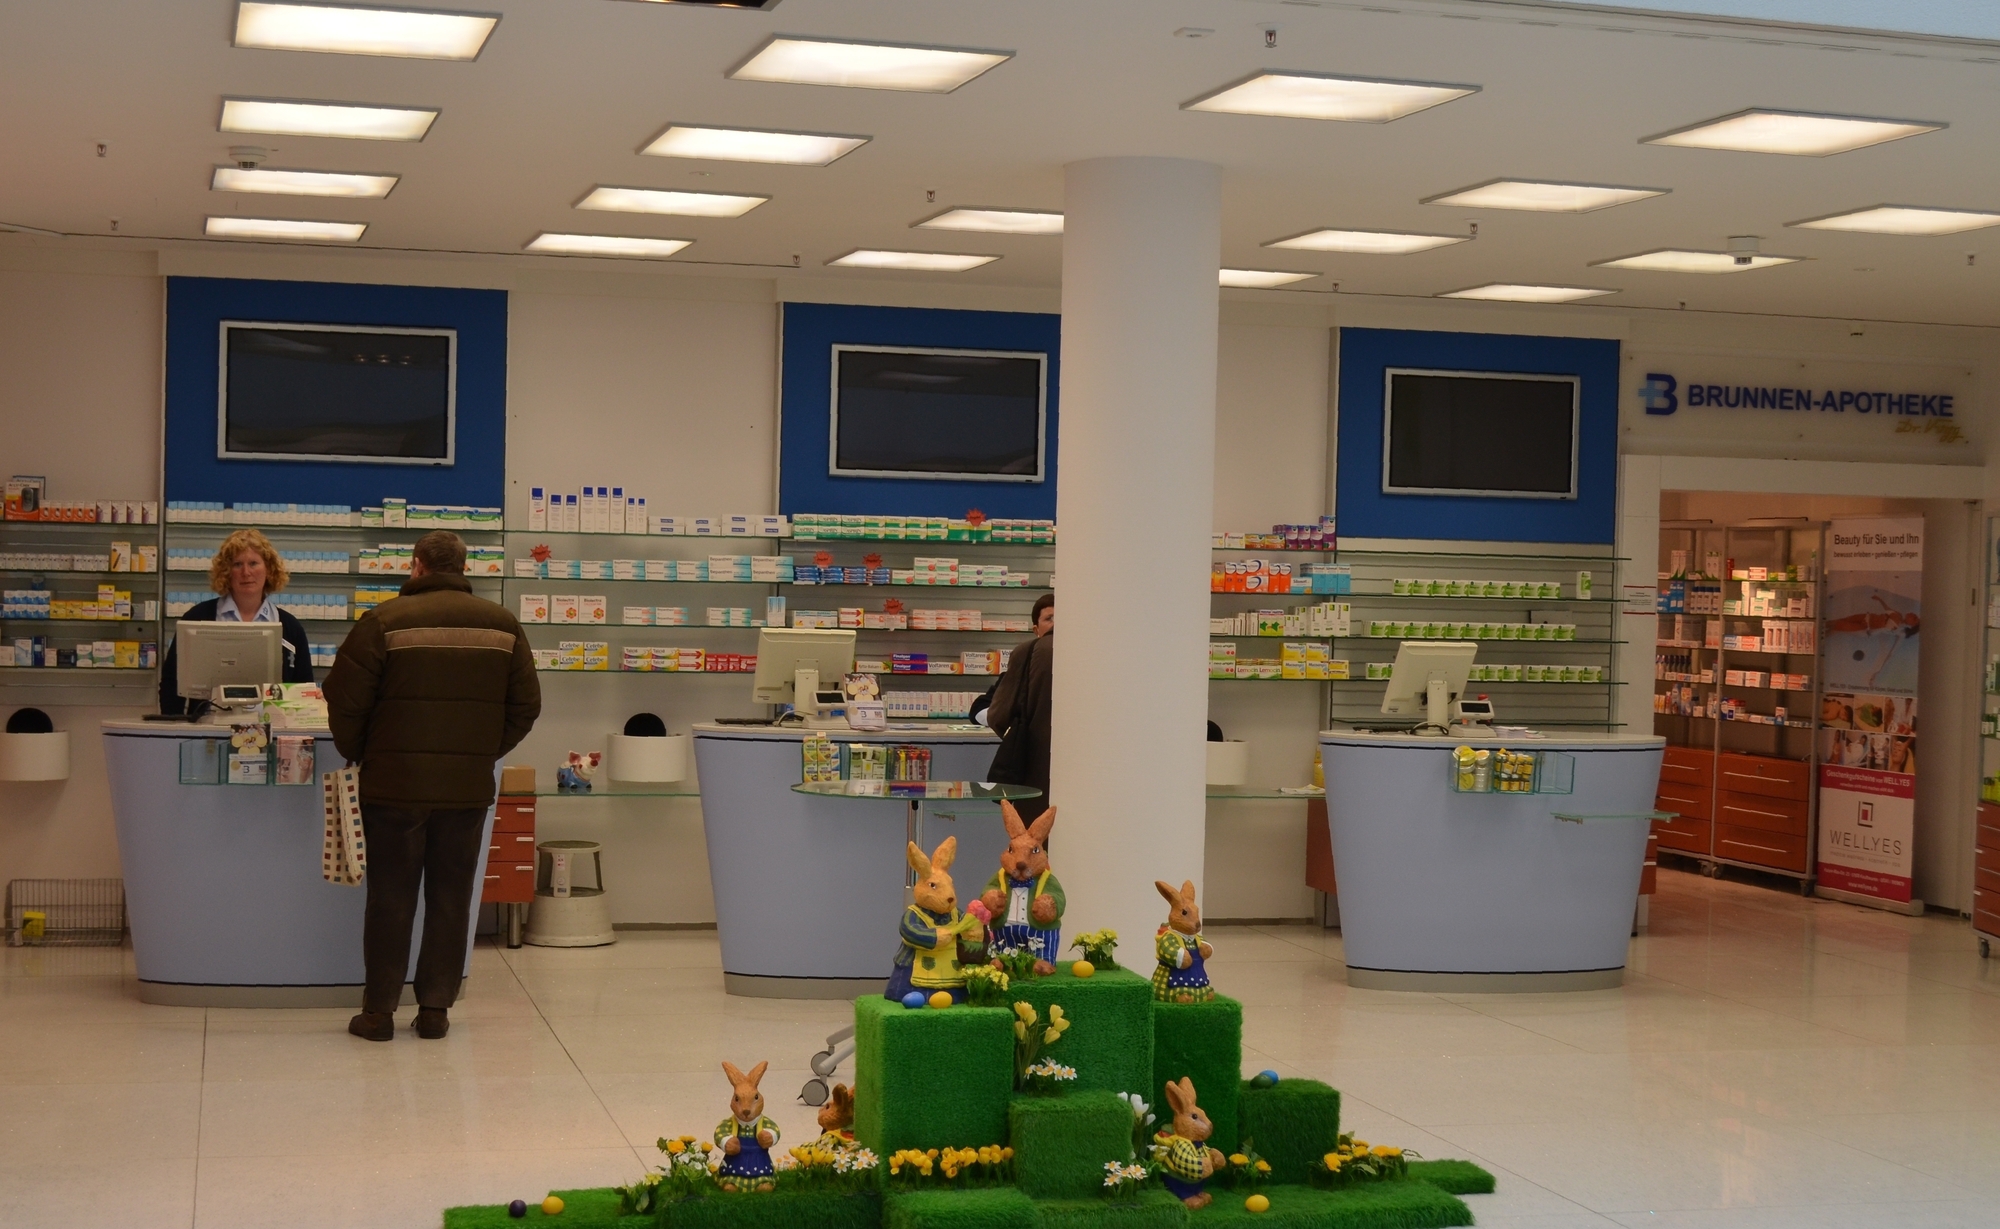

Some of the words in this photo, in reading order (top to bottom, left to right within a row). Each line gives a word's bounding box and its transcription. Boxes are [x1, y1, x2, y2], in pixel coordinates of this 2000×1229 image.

[1688, 384, 1954, 417] BRUNNEN-APOTHEKE
[1834, 534, 1860, 547] Beauty
[1862, 533, 1873, 544] für
[1875, 534, 1887, 544] Sie
[1889, 534, 1904, 544] und
[1906, 533, 1919, 544] Ihn
[1900, 551, 1918, 559] pflegen
[1826, 769, 1875, 783] Geschenkgutscheine
[1883, 776, 1910, 787] WELL.YES
[1830, 829, 1902, 856] WELL.YES
